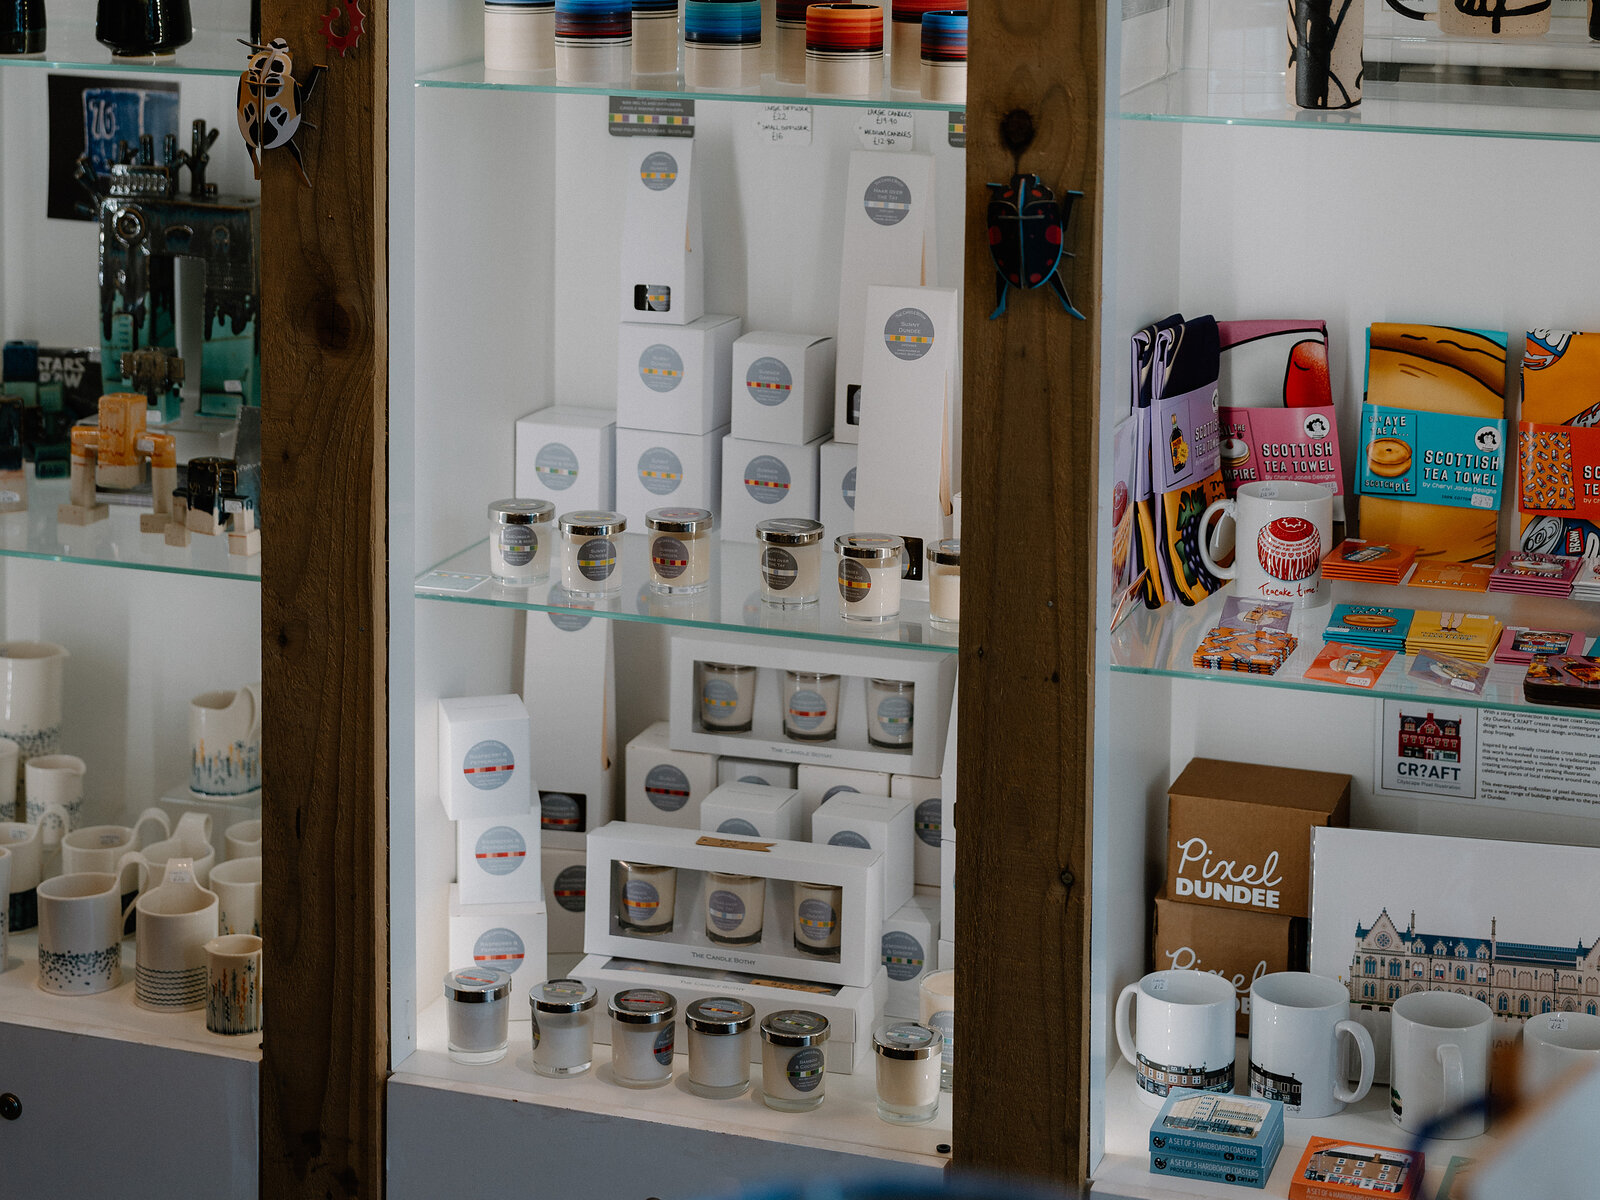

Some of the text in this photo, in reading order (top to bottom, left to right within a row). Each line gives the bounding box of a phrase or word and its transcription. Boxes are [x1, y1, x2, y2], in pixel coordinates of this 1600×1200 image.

[772, 112, 788, 121] £22
[867, 108, 913, 119] LARGE CANDLES
[886, 130, 912, 139] CANDLES
[1234, 424, 1246, 432] THE
[1384, 416, 1407, 427] AYE
[1194, 418, 1220, 442] SCOTTIS
[1370, 427, 1387, 436] TAE
[1262, 442, 1333, 458] SCOTTISH
[1264, 459, 1336, 474] TEA TOWEL
[1424, 450, 1500, 471] SCOTTISH
[1224, 468, 1257, 482] MPIRE
[1312, 474, 1336, 482] Designs
[1424, 468, 1498, 487] TEA TOWEL
[1364, 479, 1412, 493] SCOTCH PIE
[1432, 482, 1453, 491] Cheryl
[1454, 484, 1472, 492] Jones
[1472, 486, 1497, 495] Designs
[1568, 529, 1580, 554] BRAW
[1501, 568, 1564, 579] EMPIRE
[1258, 582, 1294, 597] Teacake
[1516, 712, 1543, 720] connection
[784, 748, 810, 756] CANDLE
[1397, 762, 1461, 781] CR?AFT
[1176, 836, 1283, 887] Pixel
[1175, 877, 1280, 909] DUNDEE
[706, 954, 732, 963] CANDLE
[734, 958, 756, 966] BOTHY
[1173, 1138, 1184, 1146] SET
[1196, 1140, 1230, 1152] HARDBOARD
[1230, 1144, 1258, 1156] COASTERS
[1170, 1168, 1196, 1176] PRODUCED
[1174, 1158, 1185, 1166] SET
[1185, 1160, 1192, 1168] OF
[1197, 1161, 1232, 1173] HARDBOARD
[1231, 1166, 1260, 1178] COASTERS
[1311, 1188, 1321, 1196] SET
